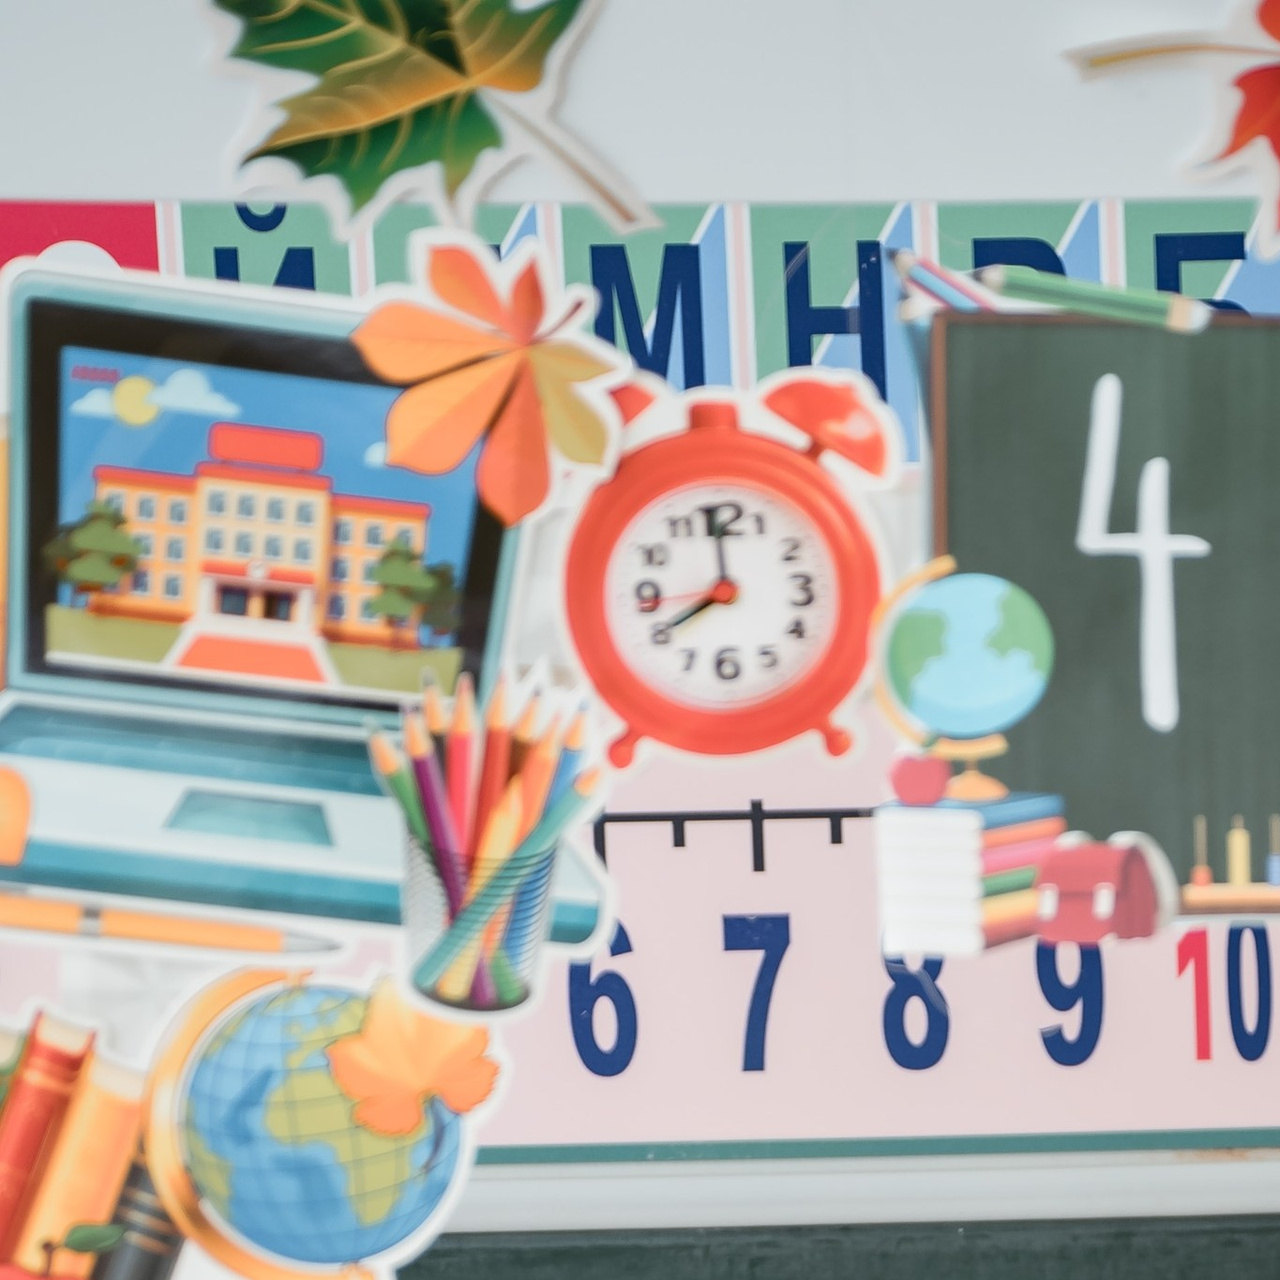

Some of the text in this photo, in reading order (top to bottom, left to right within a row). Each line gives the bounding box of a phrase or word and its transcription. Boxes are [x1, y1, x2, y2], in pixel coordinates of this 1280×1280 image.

[589, 243, 706, 390] М
[784, 240, 888, 400] Н
[698, 502, 744, 538] 12
[780, 537, 801, 562] 2
[1075, 373, 1211, 731] 4
[635, 580, 661, 613] 9
[790, 573, 815, 607] 3
[786, 616, 805, 639] 4
[715, 648, 741, 680] 6
[757, 645, 778, 668] 5
[569, 924, 638, 1077] 6
[722, 914, 791, 1072] 7
[883, 954, 950, 1071] 8
[1036, 941, 1105, 1067] 9
[1177, 920, 1273, 1062] 10
